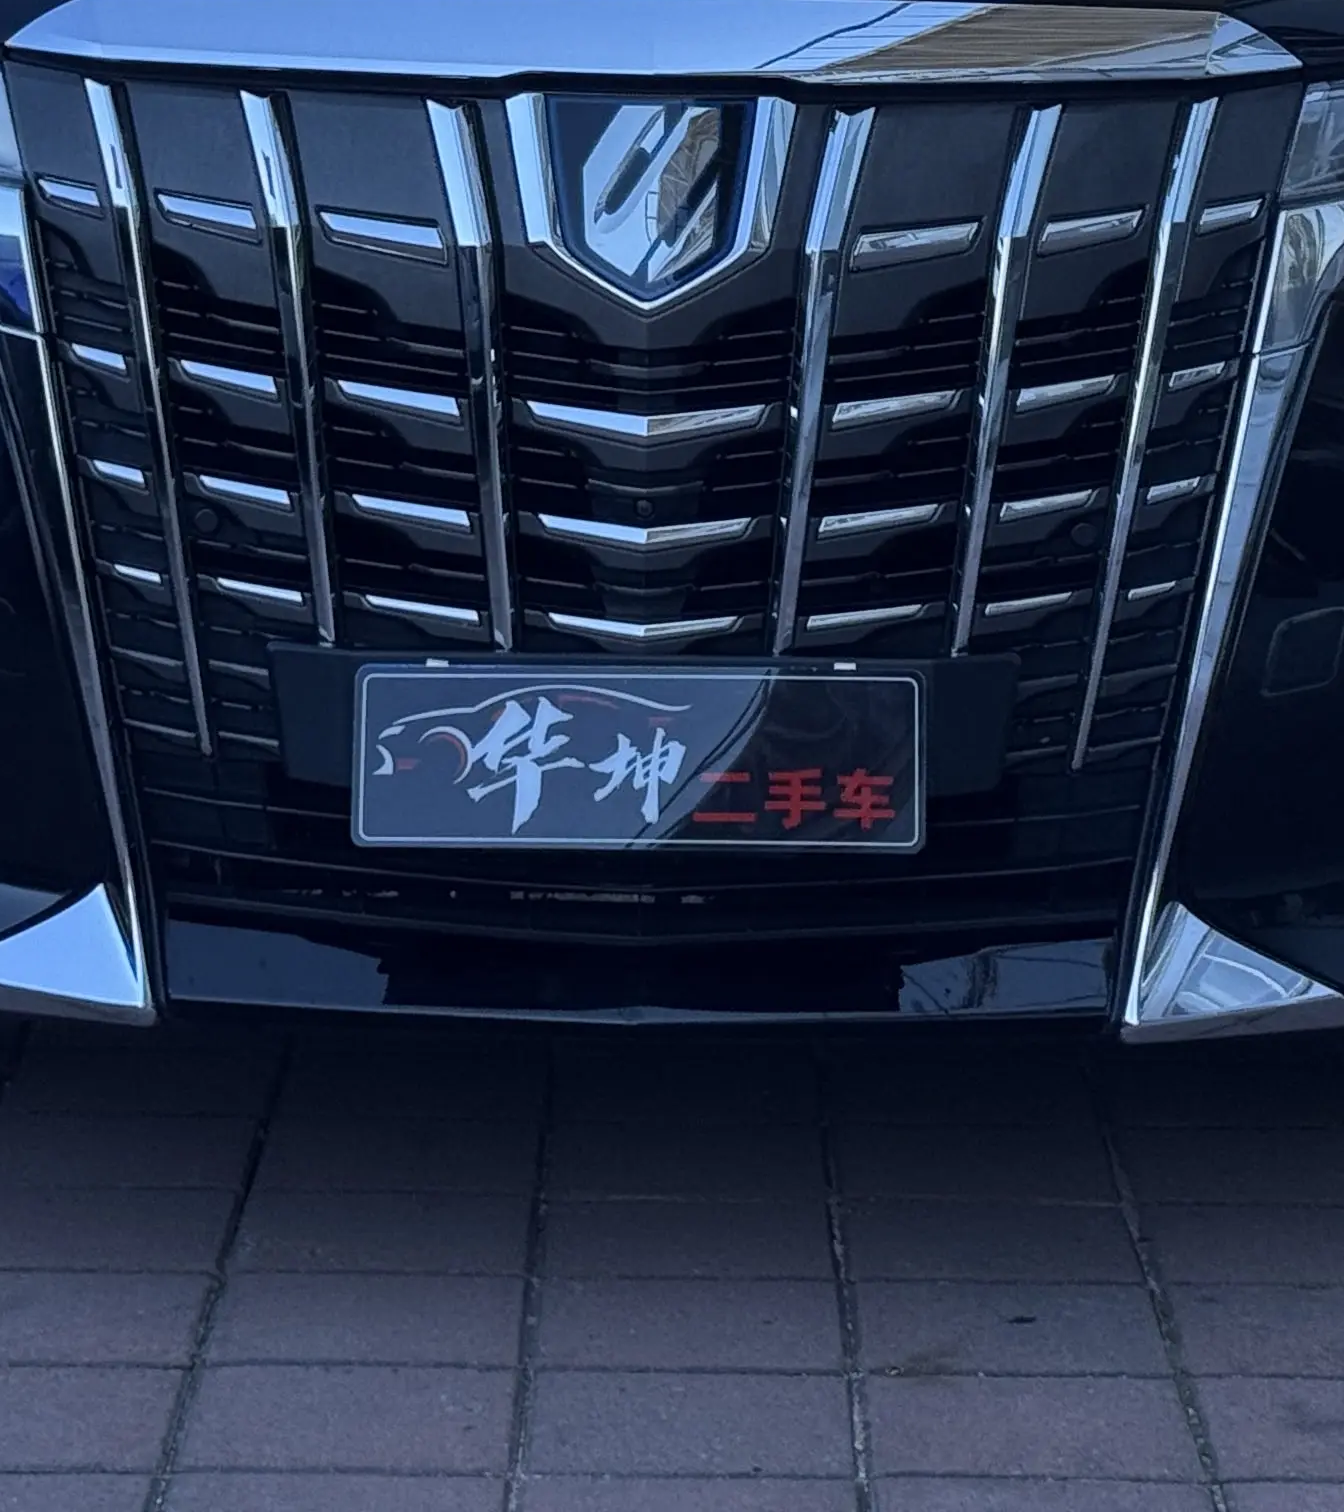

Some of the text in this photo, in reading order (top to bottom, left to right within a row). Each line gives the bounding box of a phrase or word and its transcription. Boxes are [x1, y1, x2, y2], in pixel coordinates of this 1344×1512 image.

[466, 695, 897, 834] 华坤 二手车
